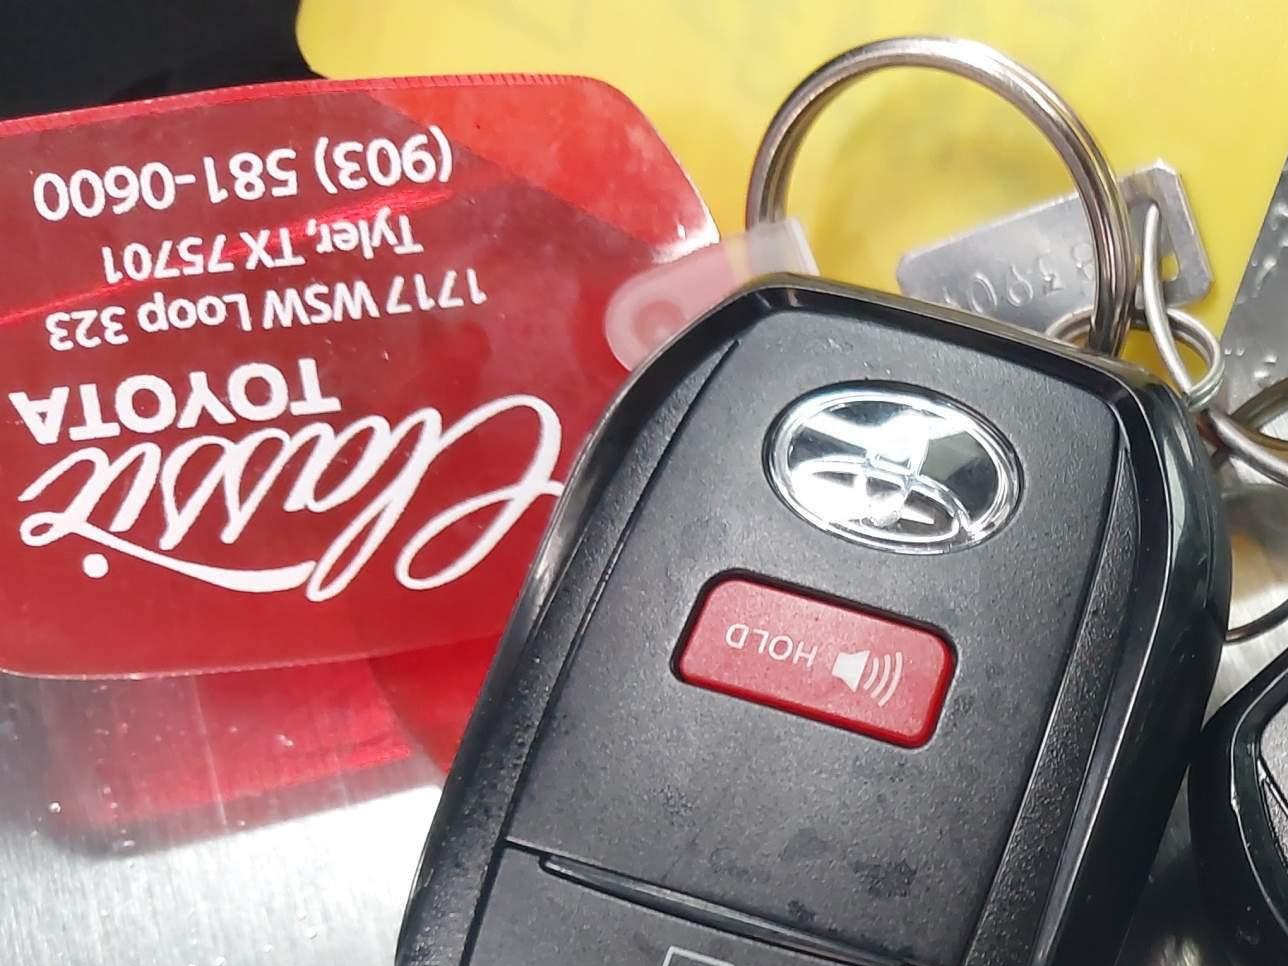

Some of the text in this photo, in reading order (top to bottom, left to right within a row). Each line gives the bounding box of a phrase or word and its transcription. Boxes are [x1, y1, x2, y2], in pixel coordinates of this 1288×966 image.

[33, 125, 453, 221] (903) 581-0600
[101, 206, 424, 284] Tyler, TX 75701
[45, 268, 488, 352] 1717 WSW Loop 323
[9, 358, 342, 445] TOYOTA
[18, 394, 567, 602] Classic
[724, 623, 819, 668] HOLD
